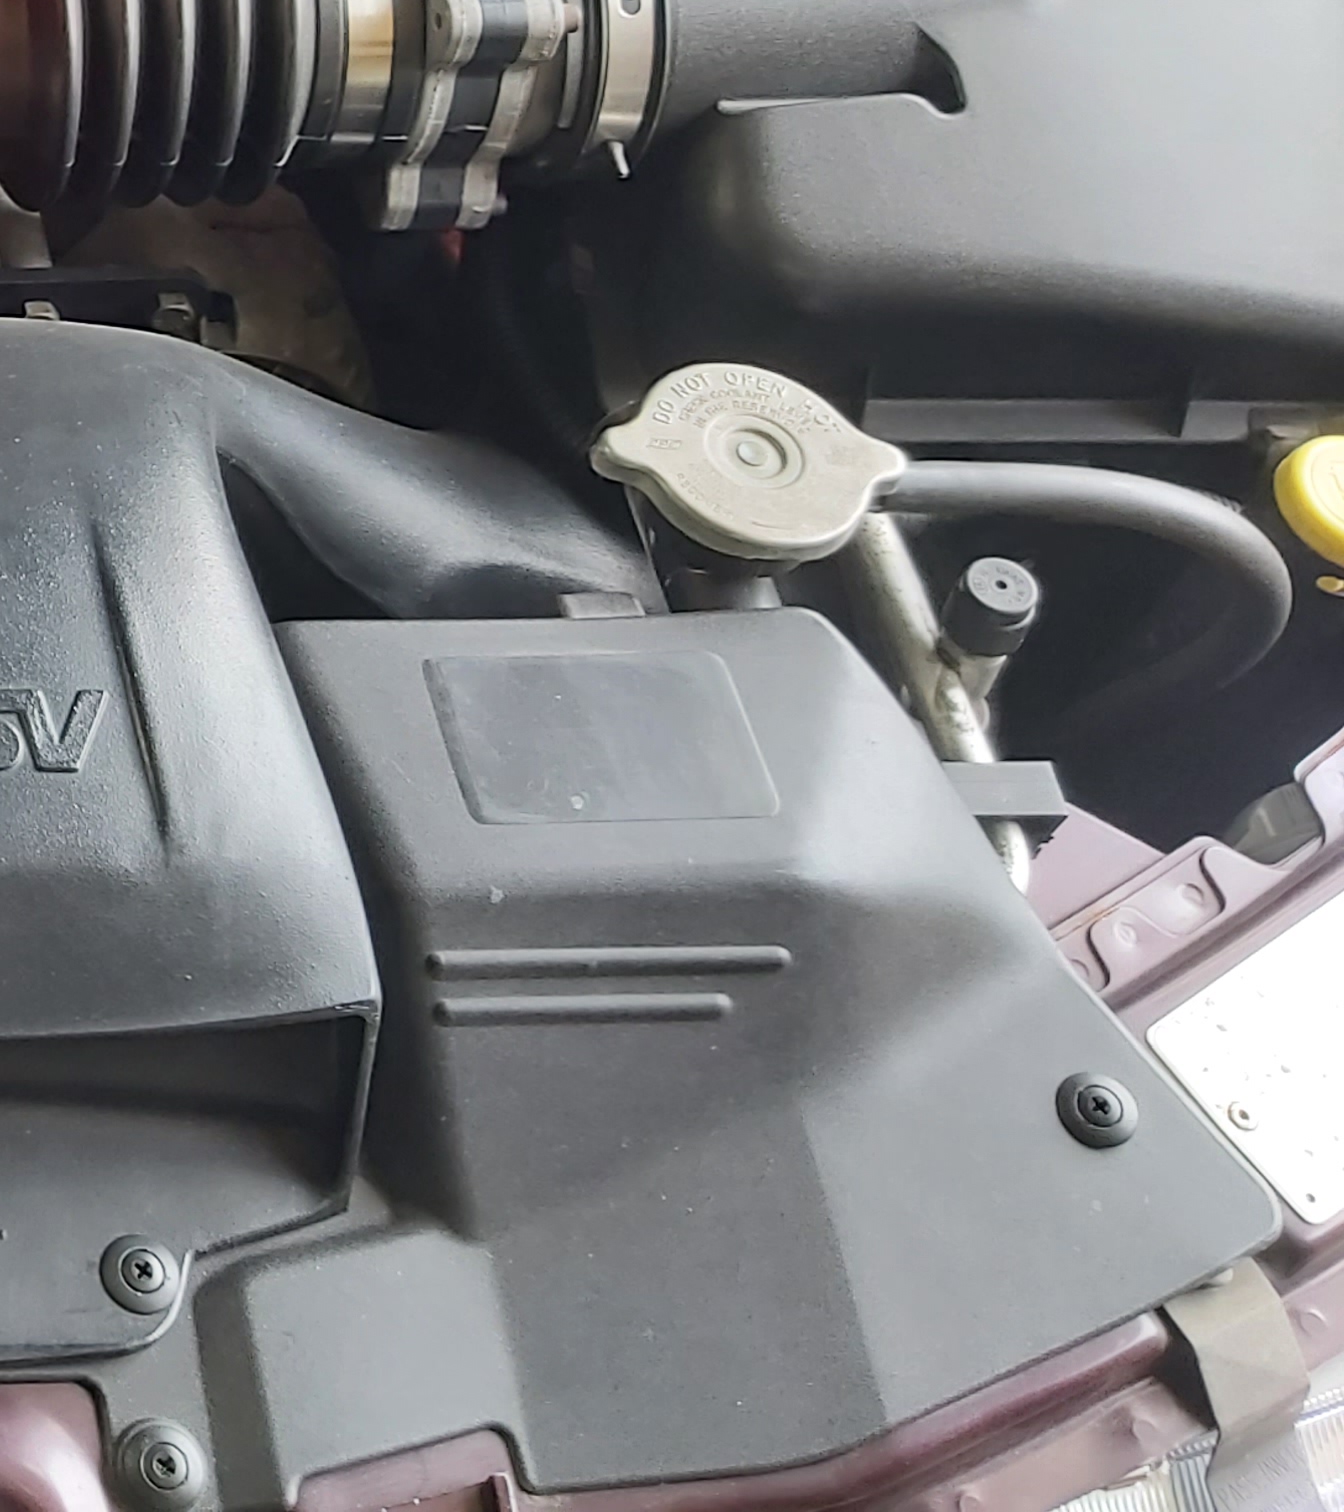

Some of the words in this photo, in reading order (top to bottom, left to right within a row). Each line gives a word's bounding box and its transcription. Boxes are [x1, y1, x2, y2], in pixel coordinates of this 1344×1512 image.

[653, 400, 674, 426] DO
[670, 371, 710, 398] NOT
[724, 370, 787, 397] OPEN
